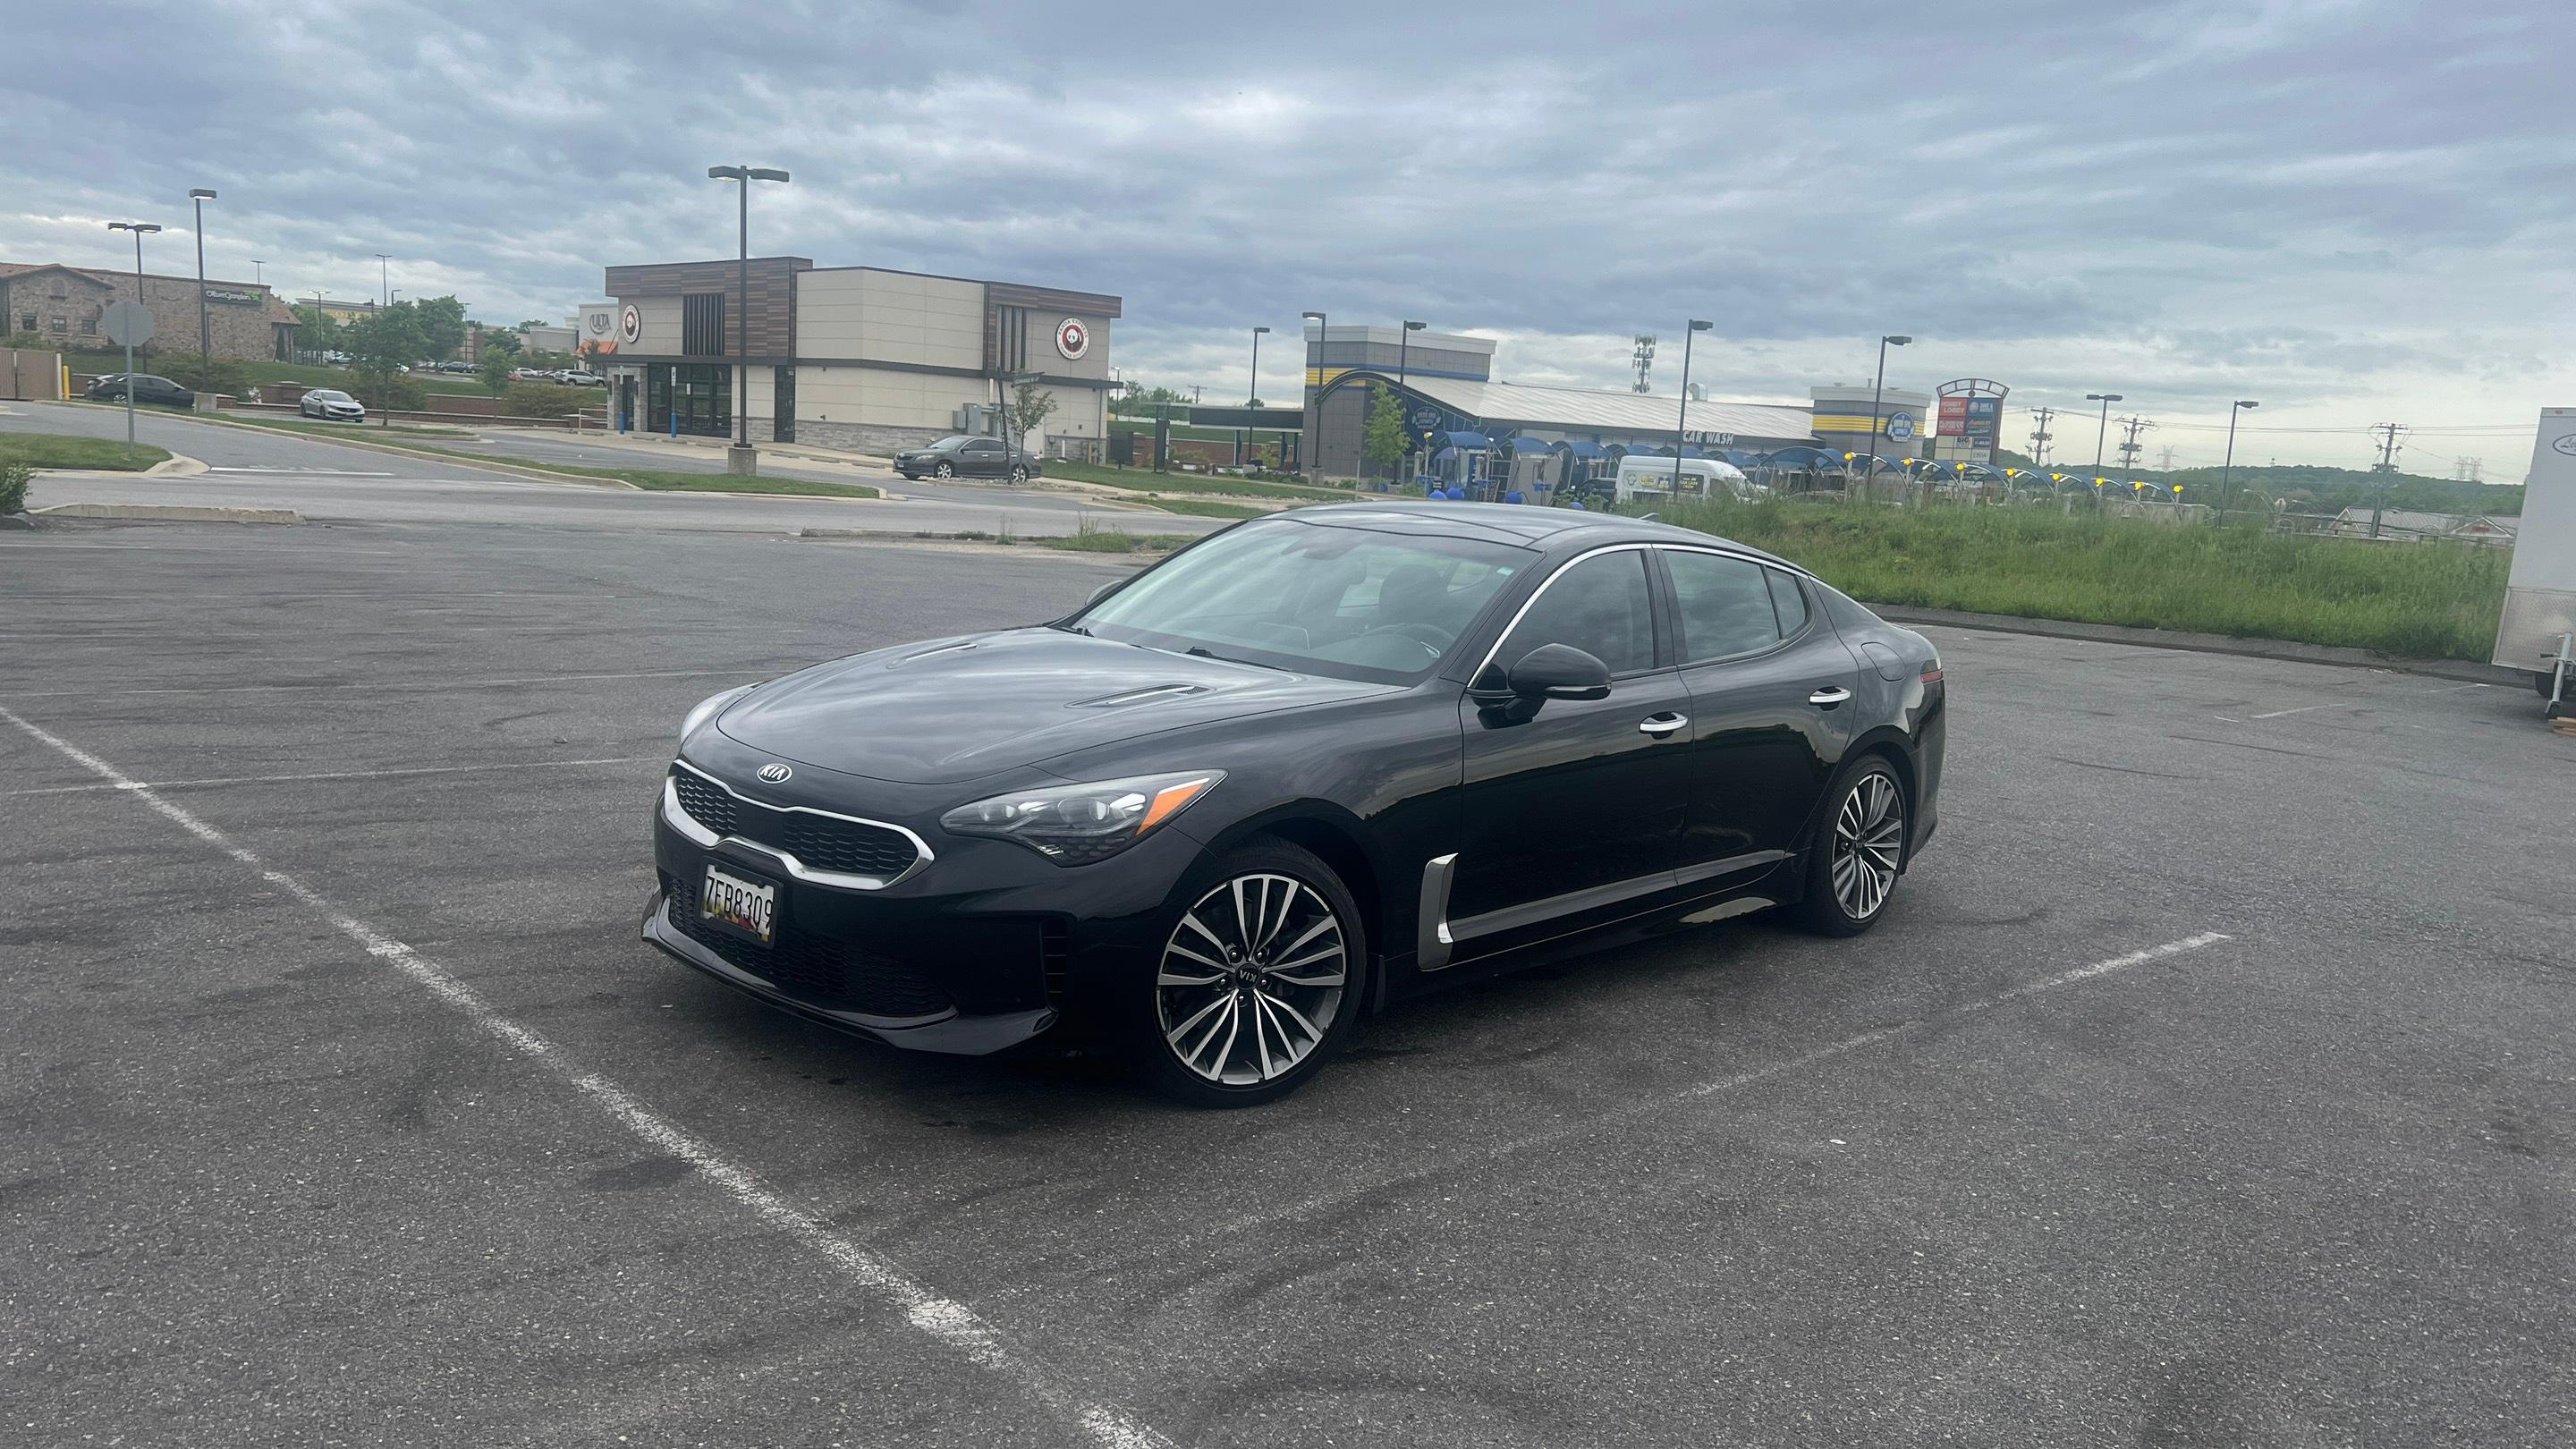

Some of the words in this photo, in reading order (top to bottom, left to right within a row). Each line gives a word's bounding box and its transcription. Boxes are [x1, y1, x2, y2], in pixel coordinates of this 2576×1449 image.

[589, 313, 611, 335] ULTA
[1058, 318, 1071, 335] PANDA
[1682, 430, 1703, 444] CAR
[1706, 431, 1734, 445] WASH
[760, 765, 786, 780] KIA
[705, 875, 773, 929] 7FB8309
